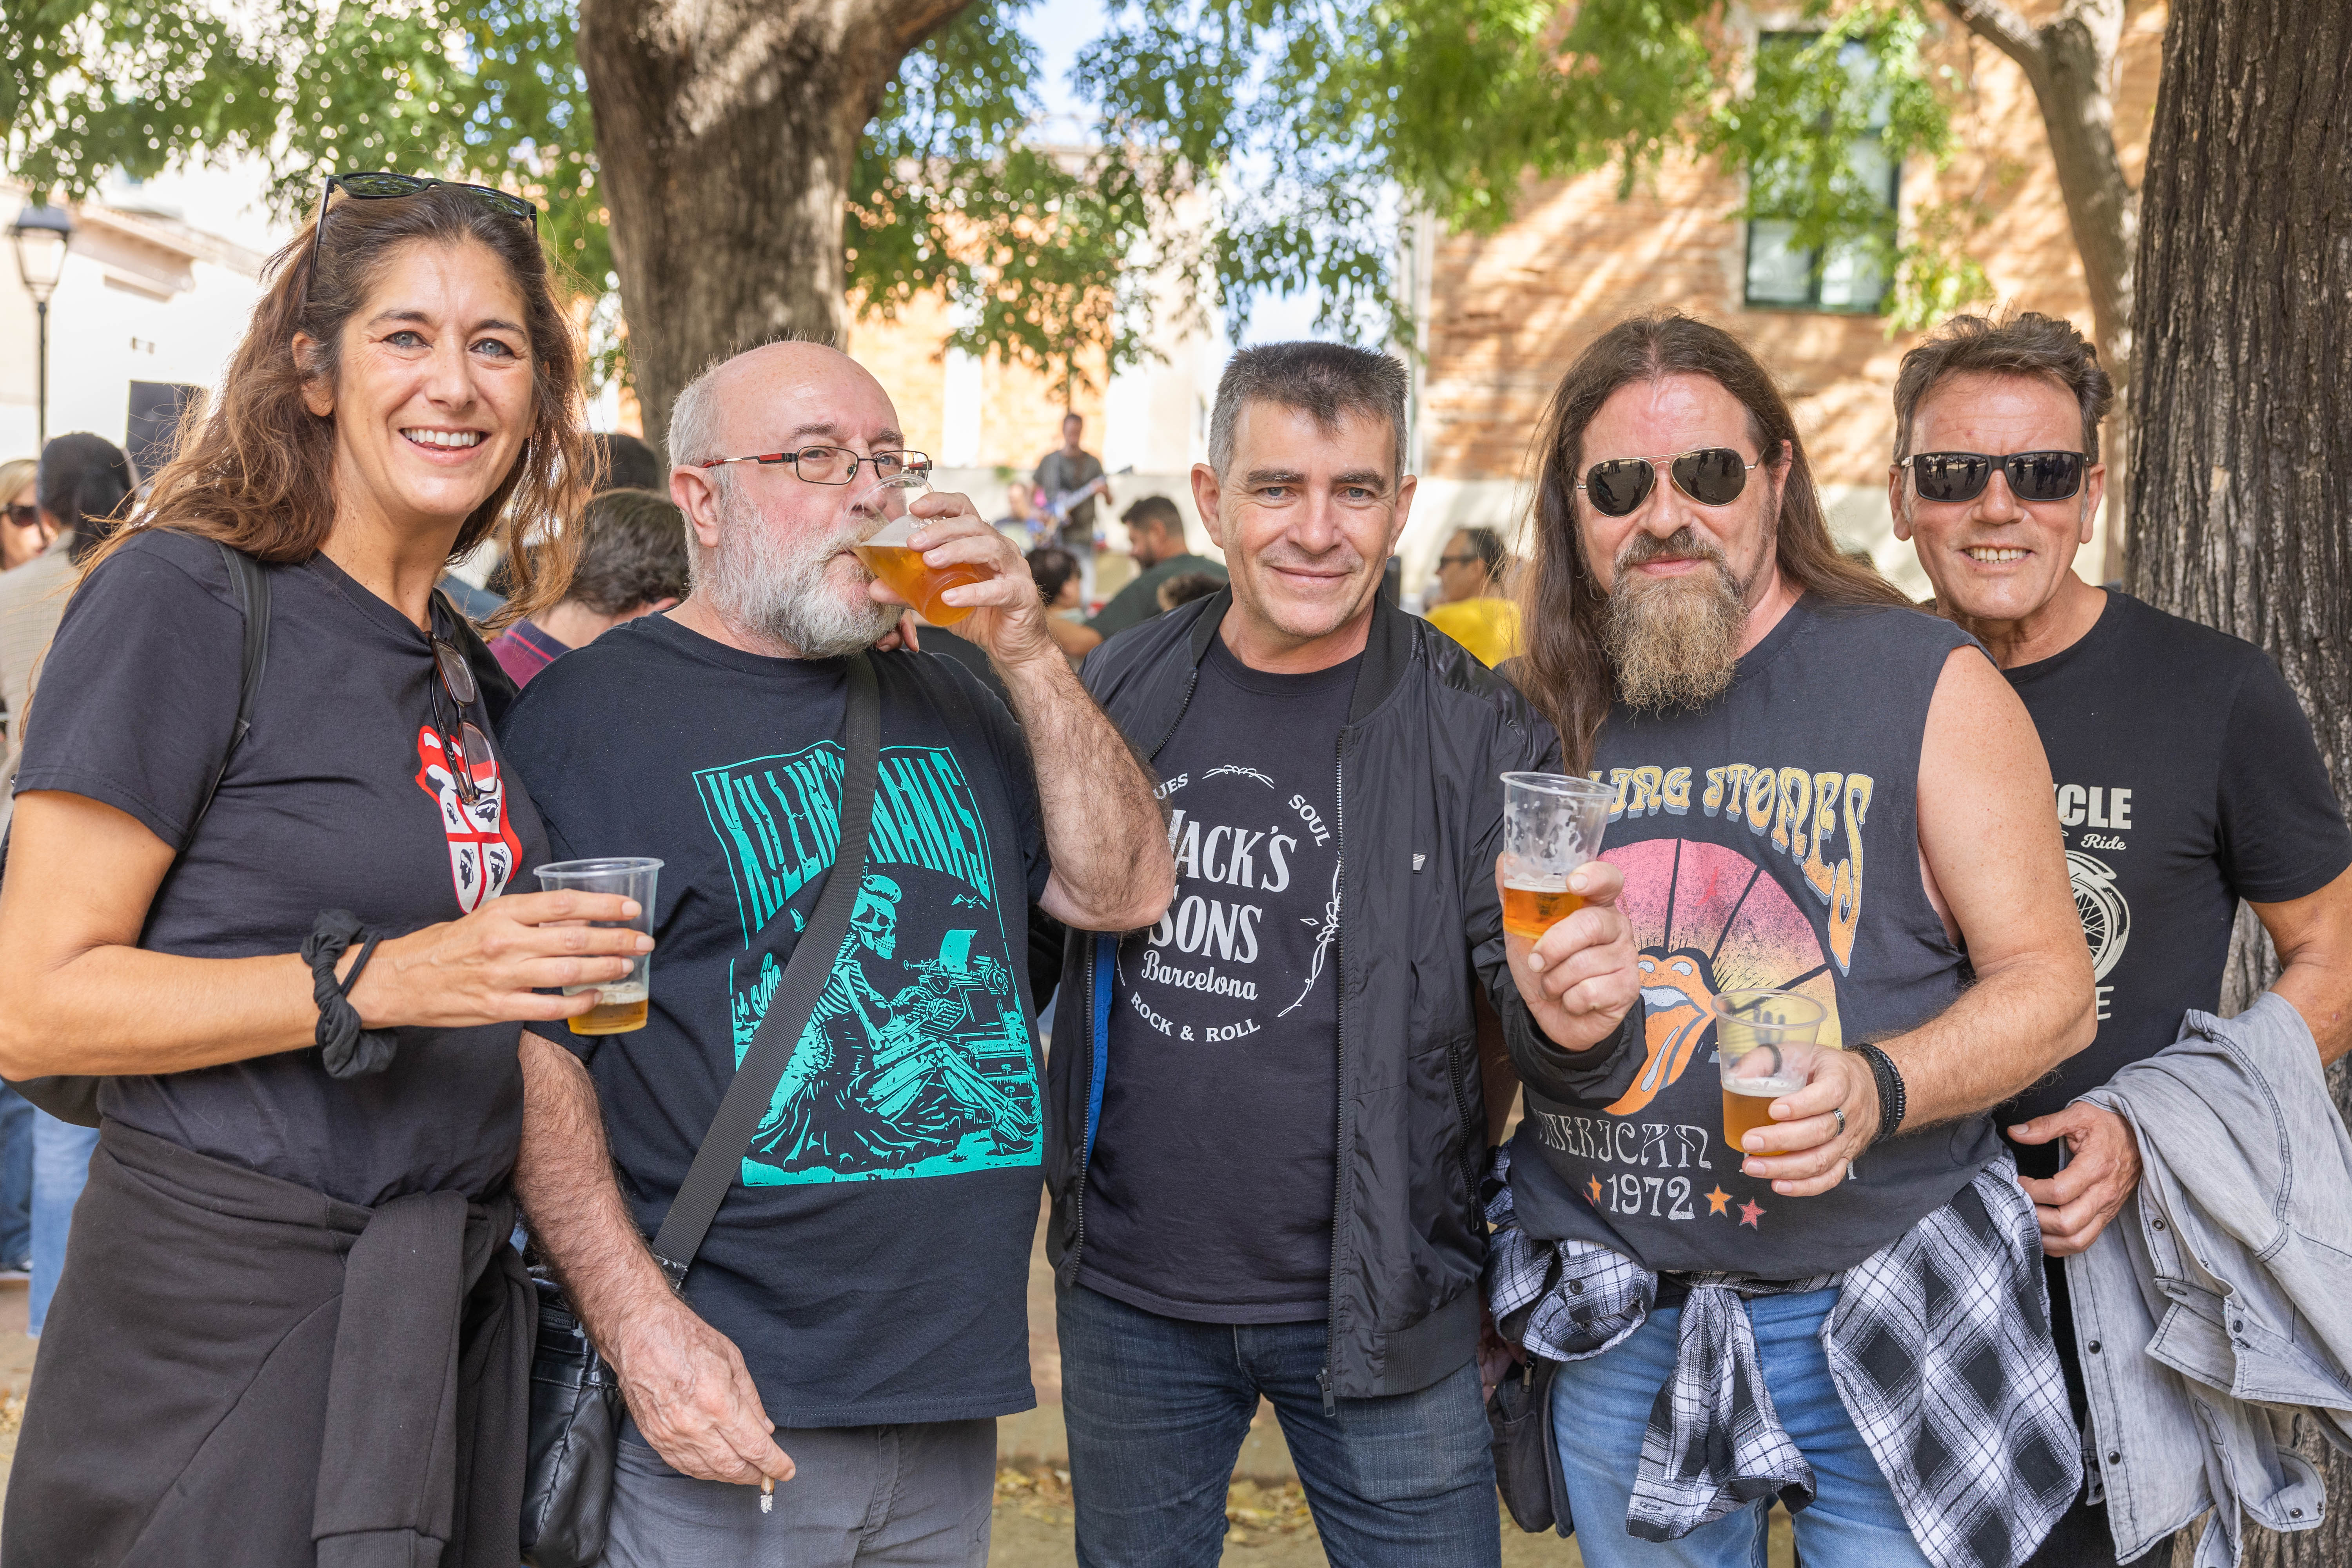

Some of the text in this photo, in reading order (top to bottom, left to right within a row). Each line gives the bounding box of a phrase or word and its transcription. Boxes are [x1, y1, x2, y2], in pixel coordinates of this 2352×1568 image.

[1288, 794, 1330, 847] SOUL
[2053, 784, 2132, 829] CLE
[1703, 763, 1874, 971] STONES
[2081, 834, 2126, 850] Ride
[1141, 949, 1258, 1001] Barcelona
[1131, 991, 1261, 1042] ROCK & ROLL
[1607, 1174, 1695, 1220] 1972
